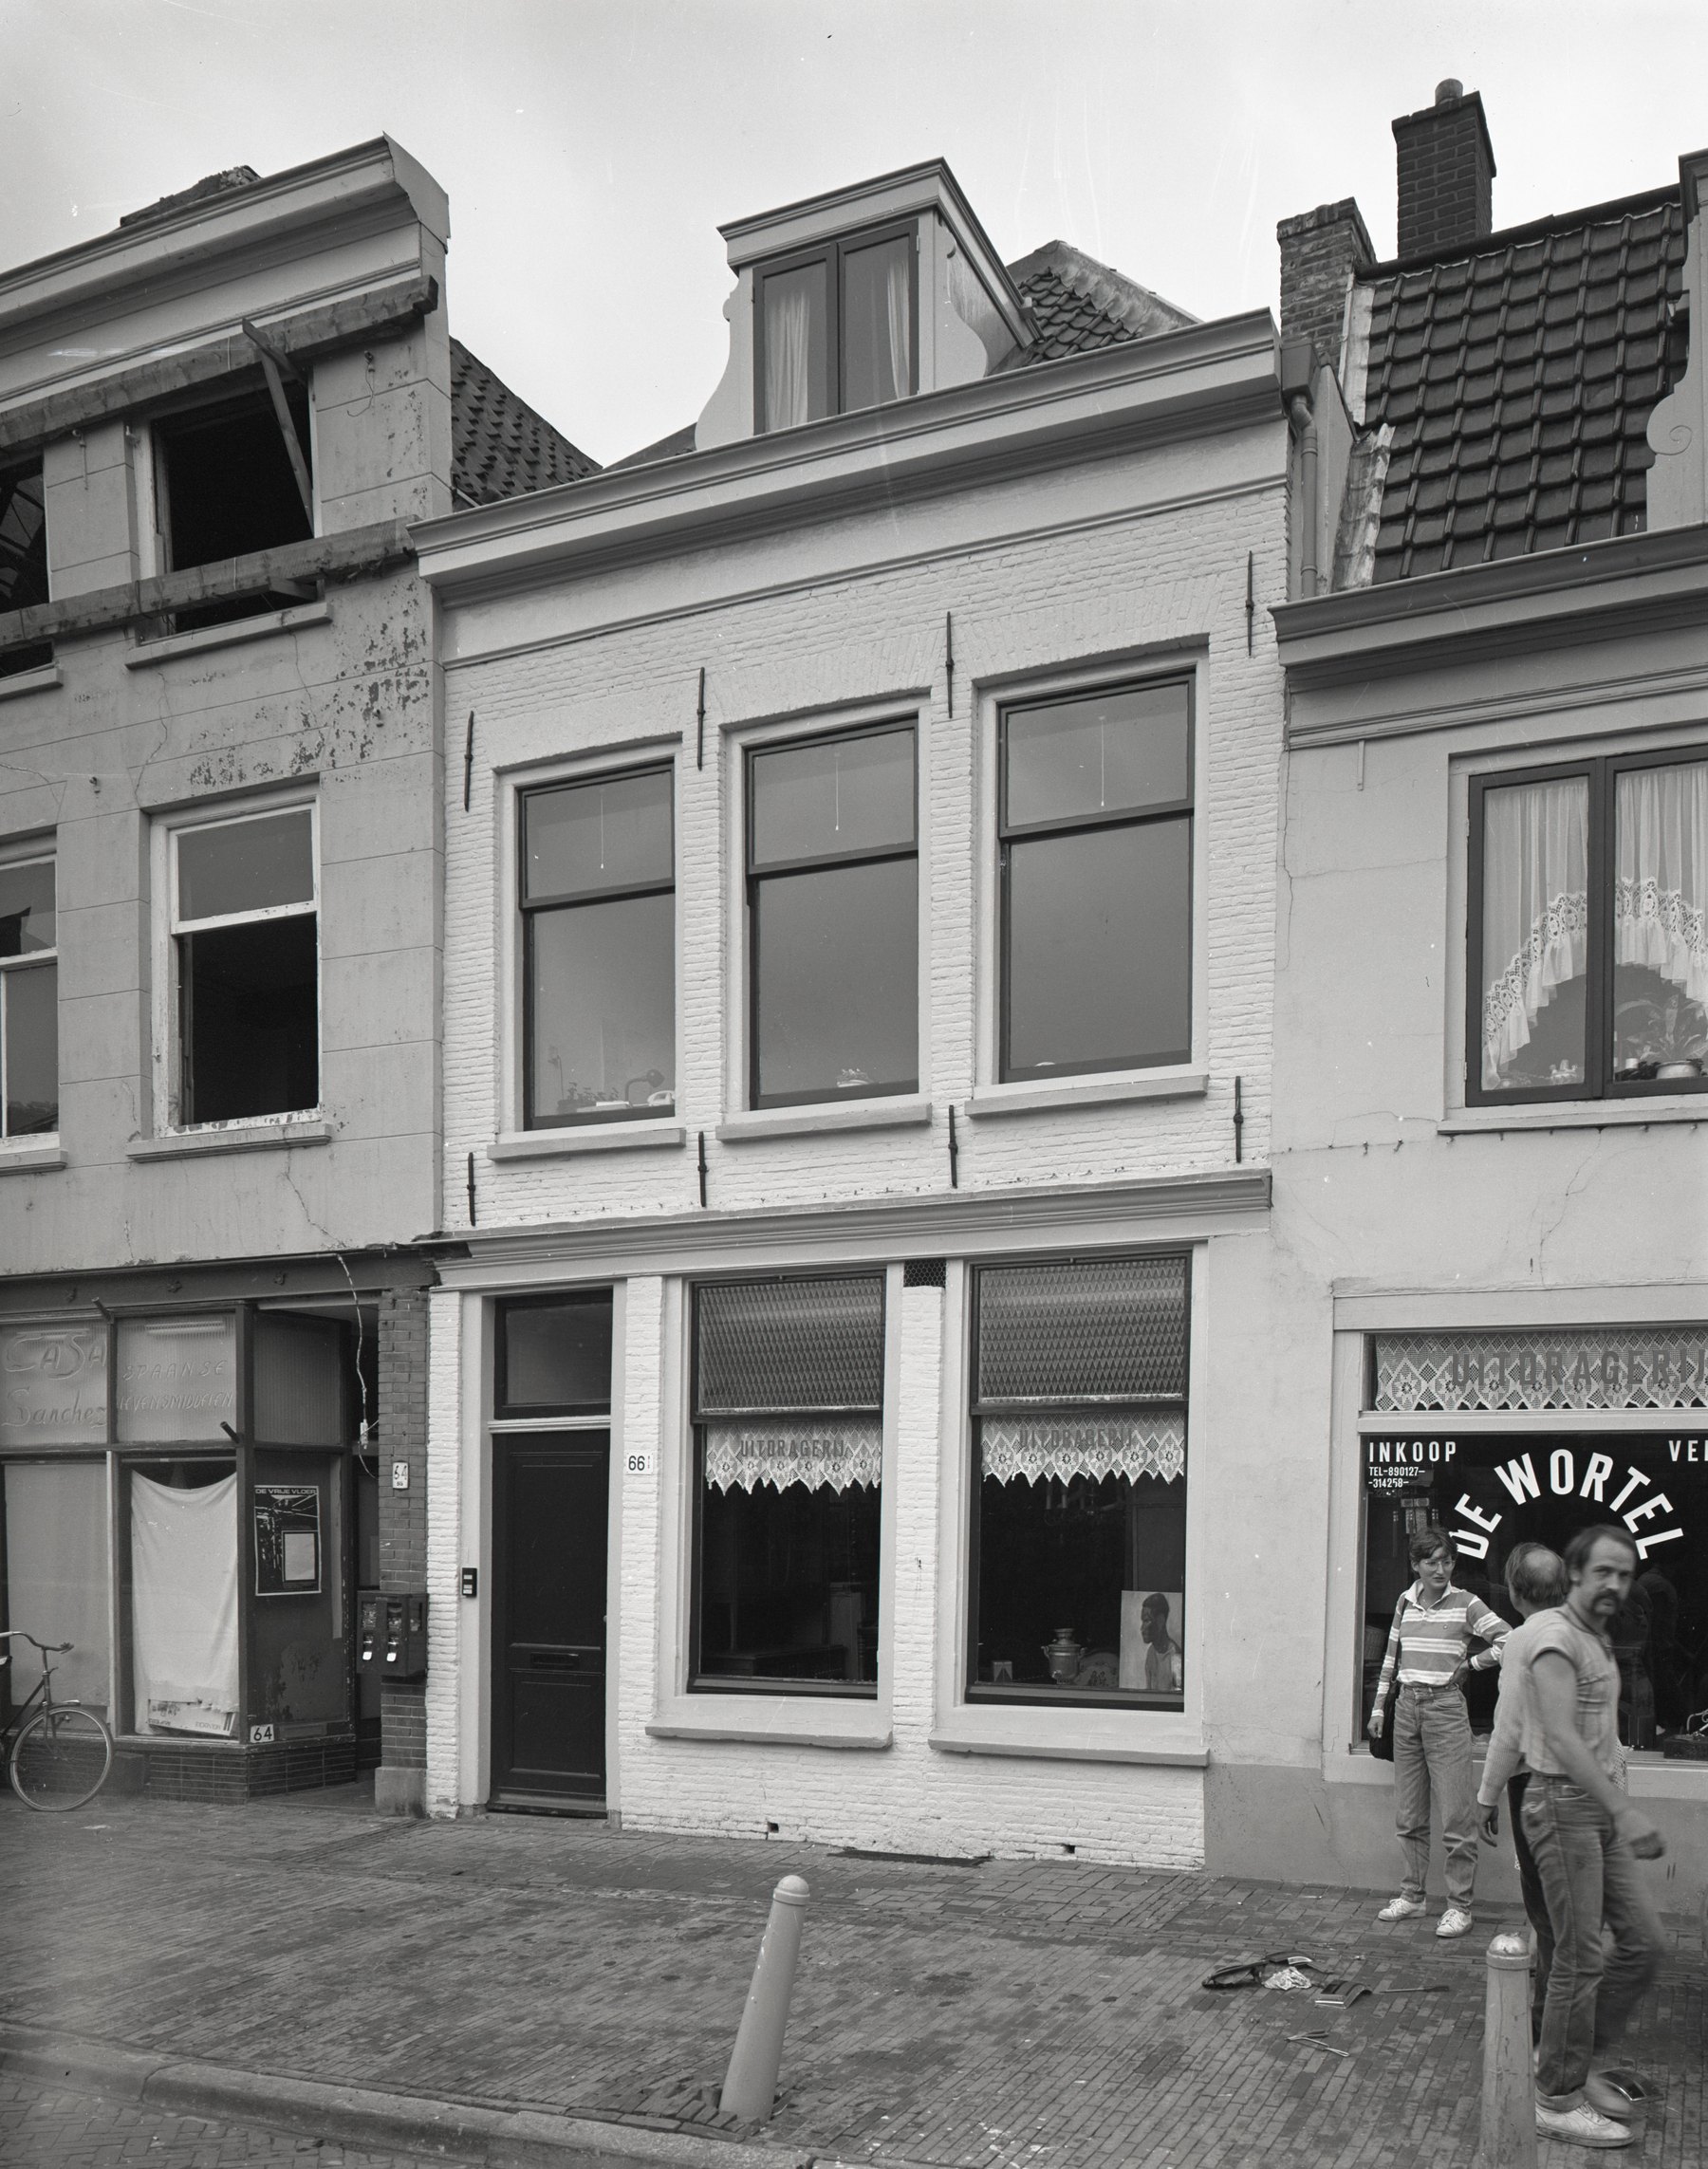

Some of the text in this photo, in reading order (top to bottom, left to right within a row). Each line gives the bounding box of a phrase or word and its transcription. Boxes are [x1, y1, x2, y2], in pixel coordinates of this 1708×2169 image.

[5, 1330, 106, 1381] CASA
[122, 1360, 228, 1381] SPAANSE
[1452, 1348, 1706, 1387] UITDRAGERIJ
[740, 1439, 845, 1458] UITDRAGERIJ
[1018, 1427, 1133, 1449] UITDRAGERIJ
[1368, 1440, 1457, 1462] INKOOP
[394, 1465, 408, 1480] 64
[628, 1455, 645, 1471] 66
[1448, 1448, 1684, 1560] DE WORTEL
[253, 1726, 272, 1741] 64
